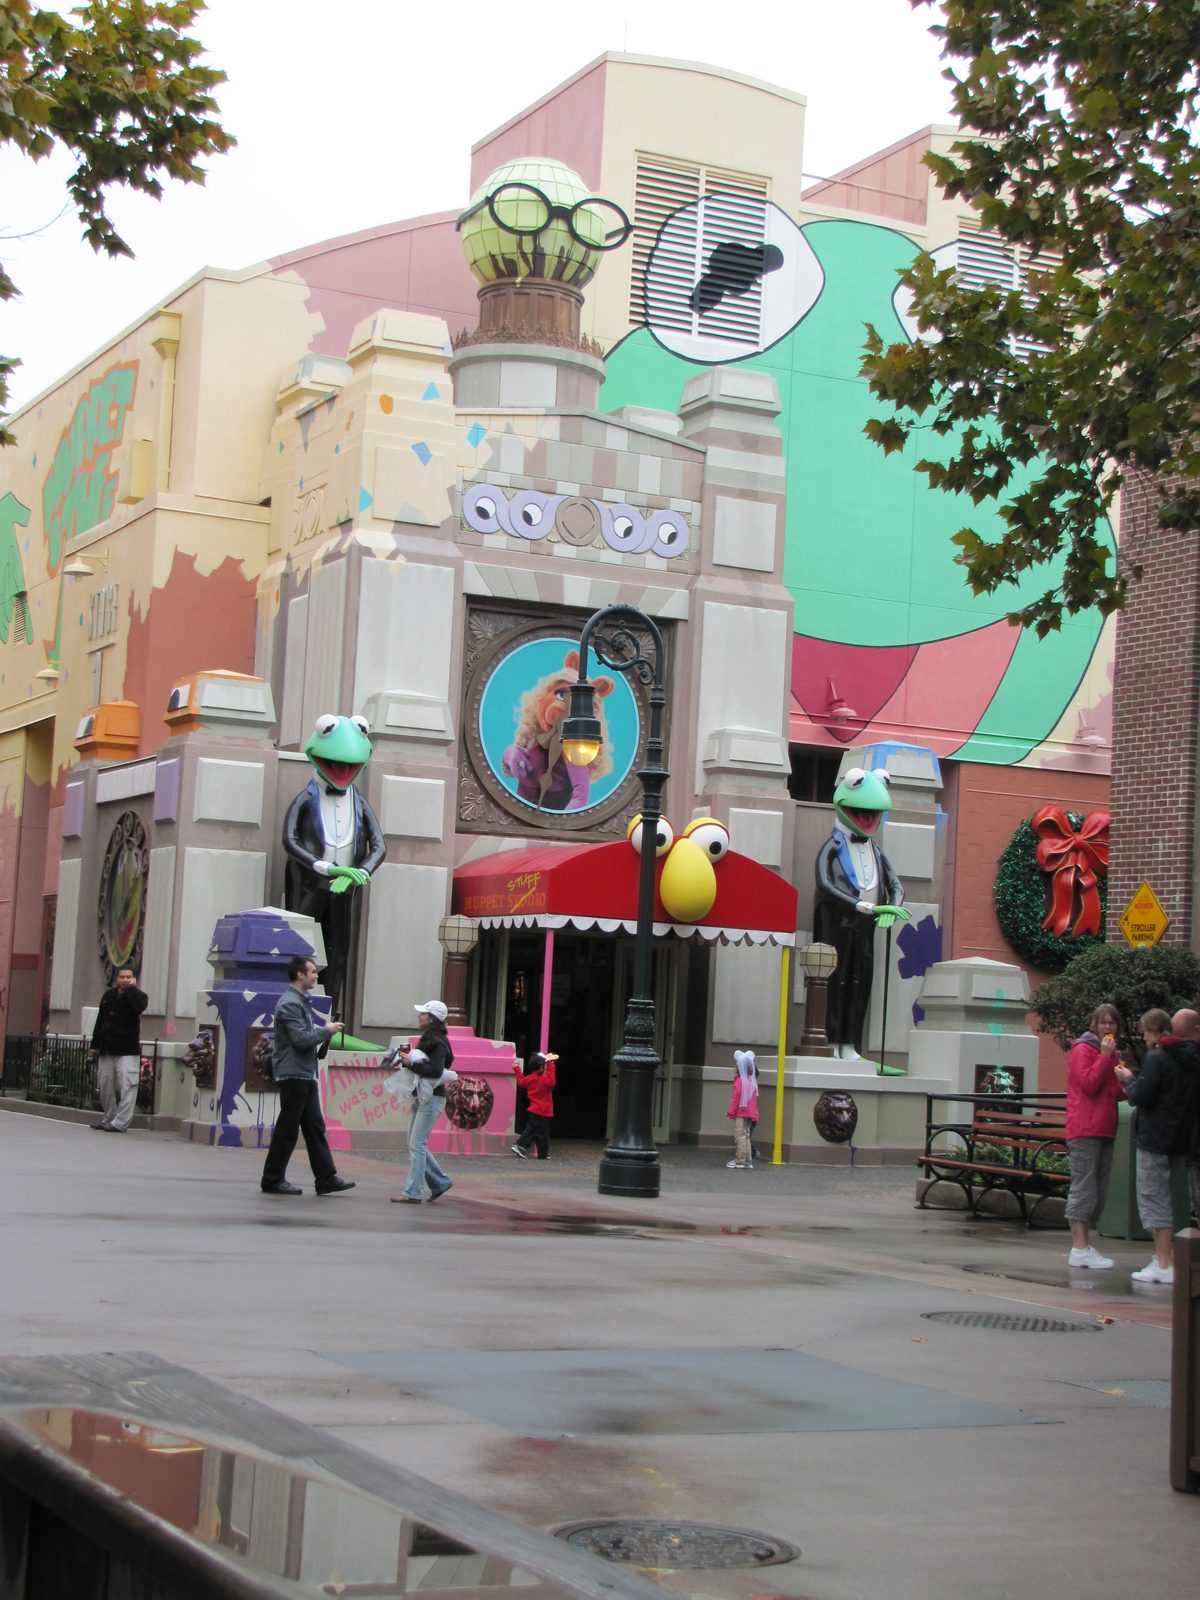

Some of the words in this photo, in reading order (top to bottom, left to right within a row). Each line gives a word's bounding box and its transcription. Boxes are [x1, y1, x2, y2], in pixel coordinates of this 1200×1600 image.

[88, 583, 118, 642] STAGE
[507, 872, 542, 891] STUFF
[464, 894, 505, 909] MUPPET
[1132, 933, 1154, 941] PARKING
[339, 1088, 368, 1115] was
